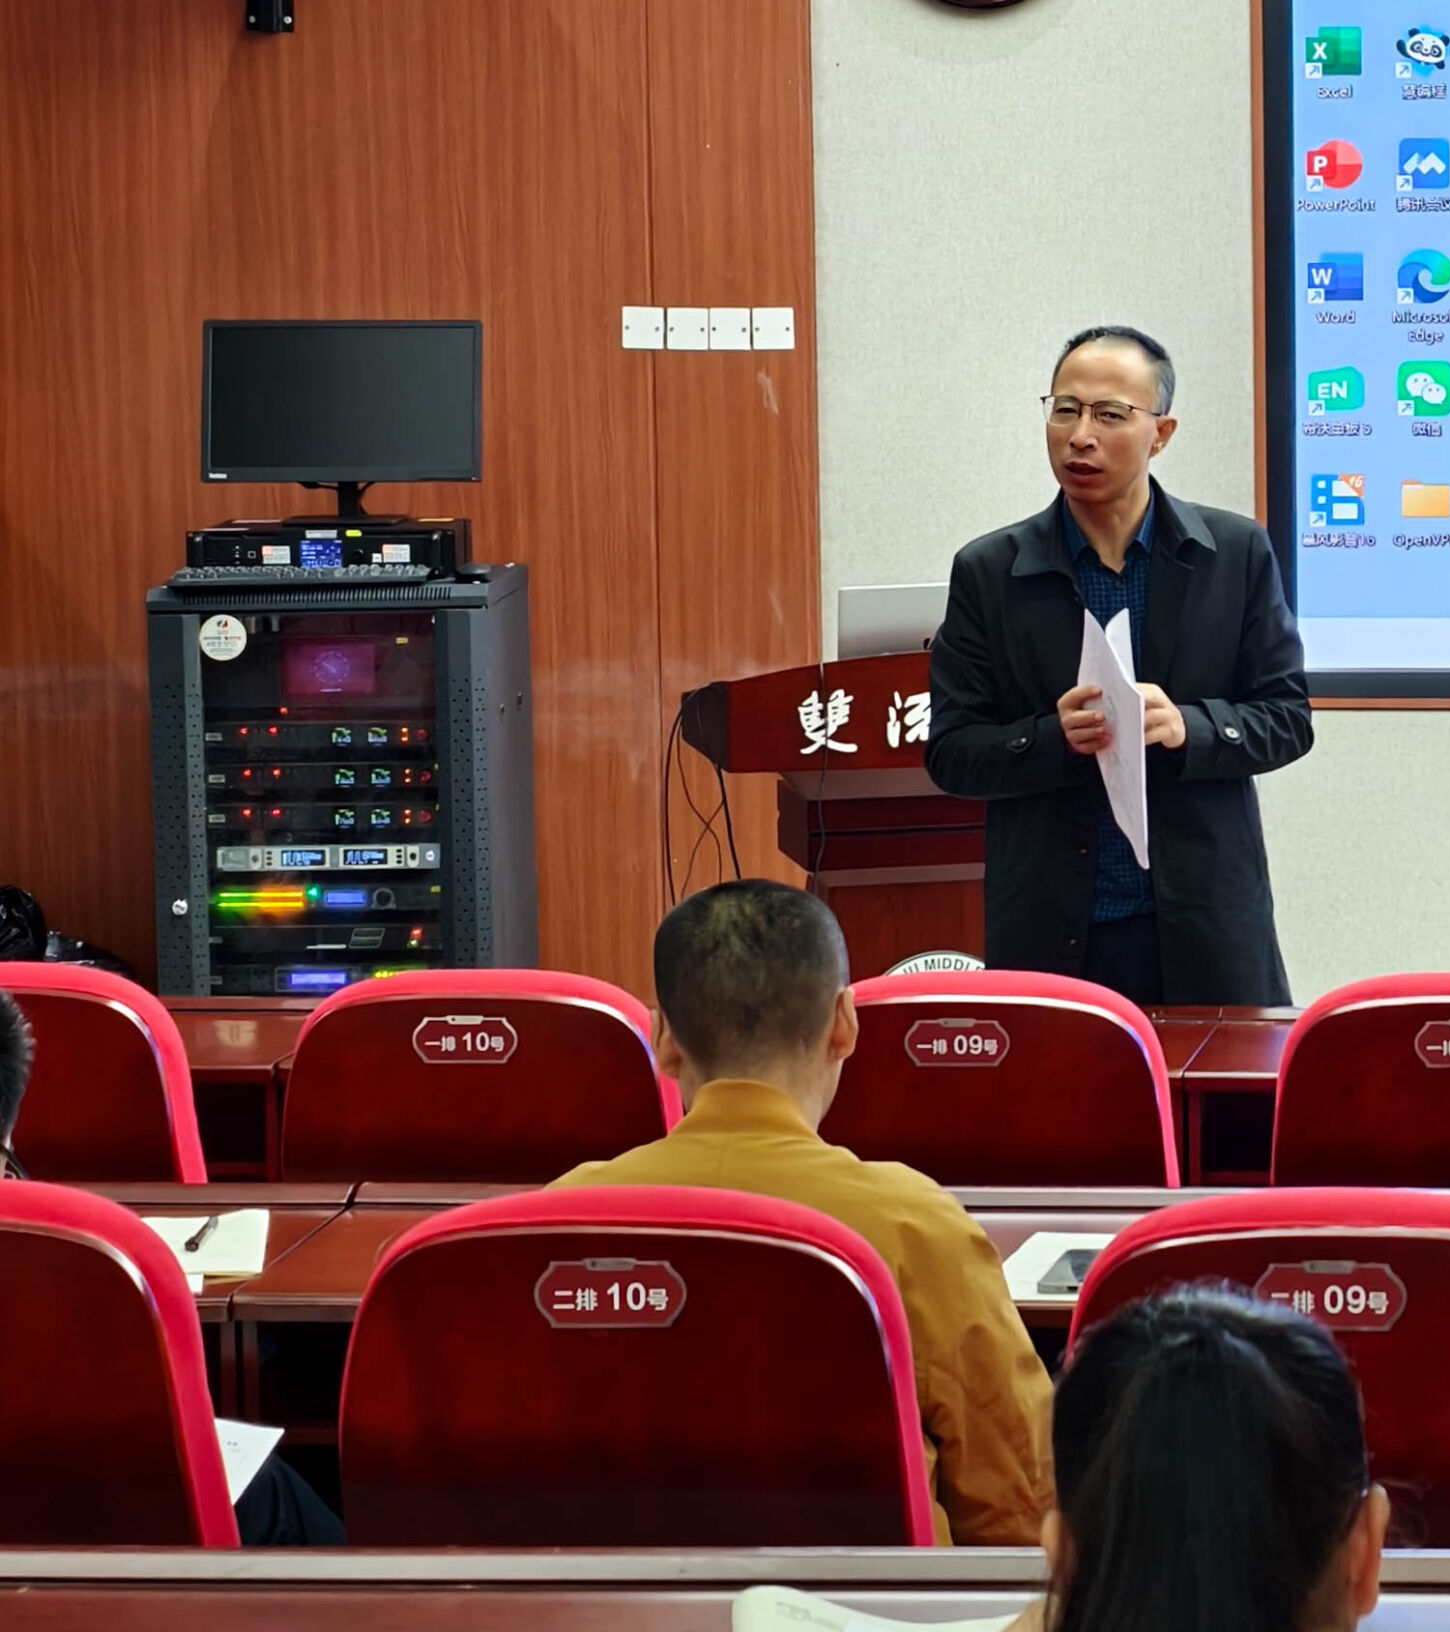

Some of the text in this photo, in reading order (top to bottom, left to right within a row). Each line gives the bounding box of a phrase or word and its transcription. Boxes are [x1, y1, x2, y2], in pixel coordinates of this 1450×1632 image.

[1317, 84, 1353, 98] Excel
[1297, 199, 1376, 213] PowerPoint
[1316, 310, 1356, 324] Word
[1408, 329, 1444, 345] Edge
[1317, 380, 1348, 399] EN
[1412, 422, 1442, 437] 微信
[424, 1032, 505, 1052] 一排 10号
[916, 1034, 998, 1055] 一排 09号
[553, 1282, 669, 1312] 二排 10号
[1323, 1284, 1389, 1315] 09号
